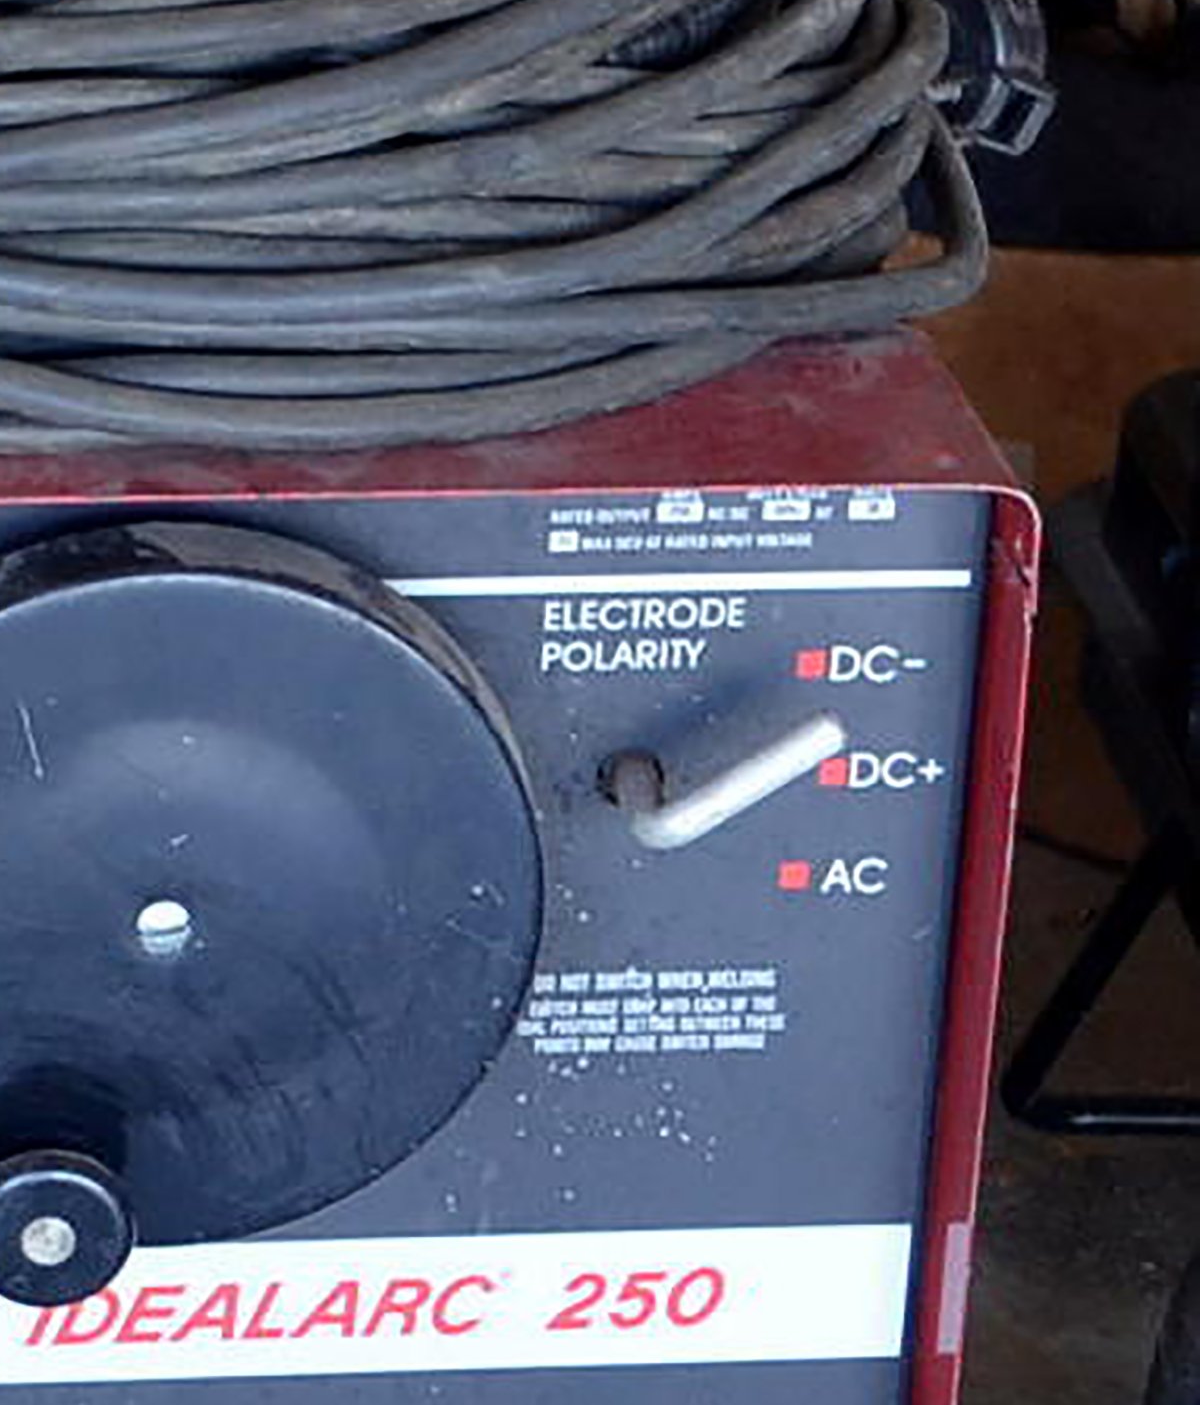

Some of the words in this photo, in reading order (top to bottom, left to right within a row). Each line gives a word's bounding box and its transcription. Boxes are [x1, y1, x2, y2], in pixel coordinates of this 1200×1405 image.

[543, 598, 747, 631] ELECTRODE
[540, 639, 706, 672] POLARITY
[848, 752, 945, 789] DC+
[820, 858, 889, 894] AC
[24, 1275, 497, 1347] IDEALARC
[545, 1266, 726, 1332] 250
